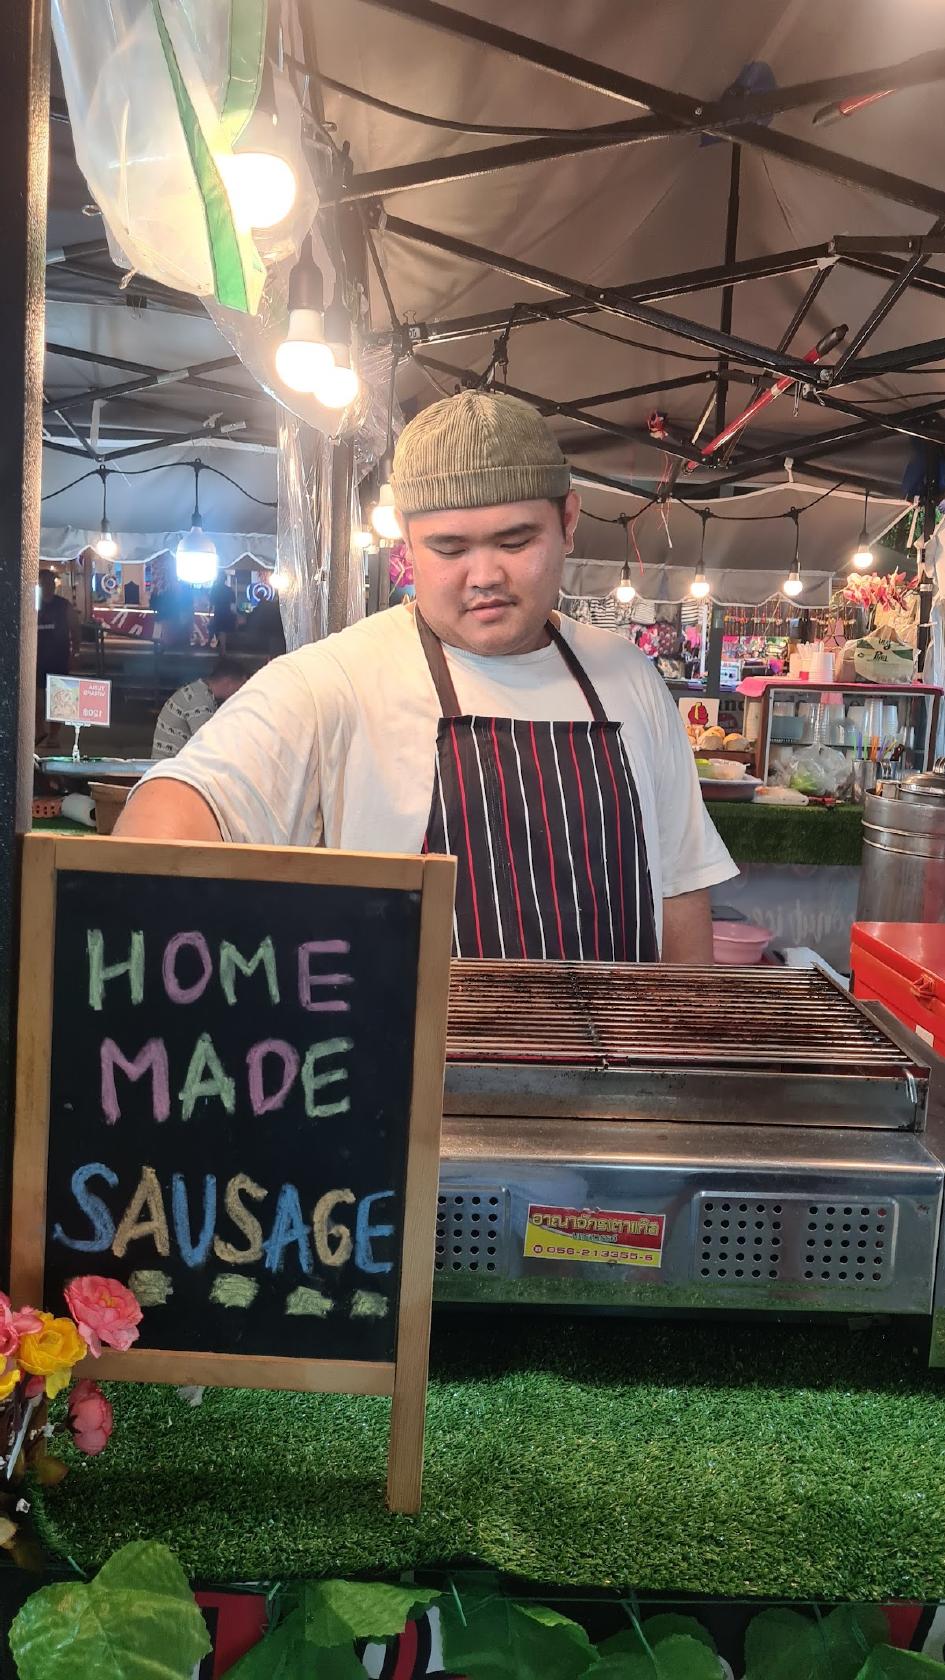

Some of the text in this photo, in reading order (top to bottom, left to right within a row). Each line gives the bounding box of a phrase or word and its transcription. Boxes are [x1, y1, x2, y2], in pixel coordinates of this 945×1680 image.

[87, 929, 354, 1011] HOME
[100, 1032, 354, 1125] MADE
[53, 1162, 397, 1274] SAUSAGE
